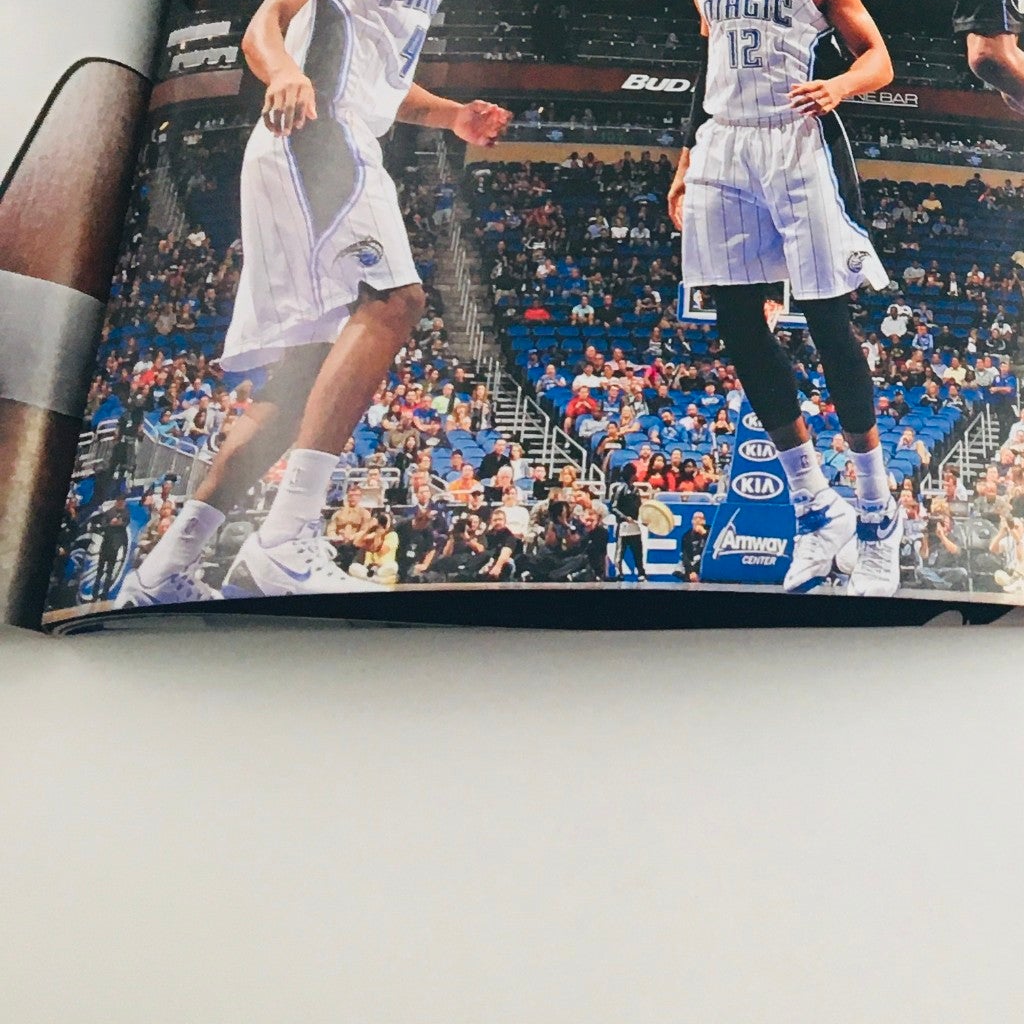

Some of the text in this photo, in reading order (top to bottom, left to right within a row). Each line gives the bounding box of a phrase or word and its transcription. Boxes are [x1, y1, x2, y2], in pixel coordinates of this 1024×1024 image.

[726, 28, 763, 70] 12
[880, 92, 919, 105] BAR
[745, 444, 774, 457] KIA
[740, 476, 775, 494] KIA
[718, 527, 788, 557] Amway
[741, 555, 777, 566] CENTER
